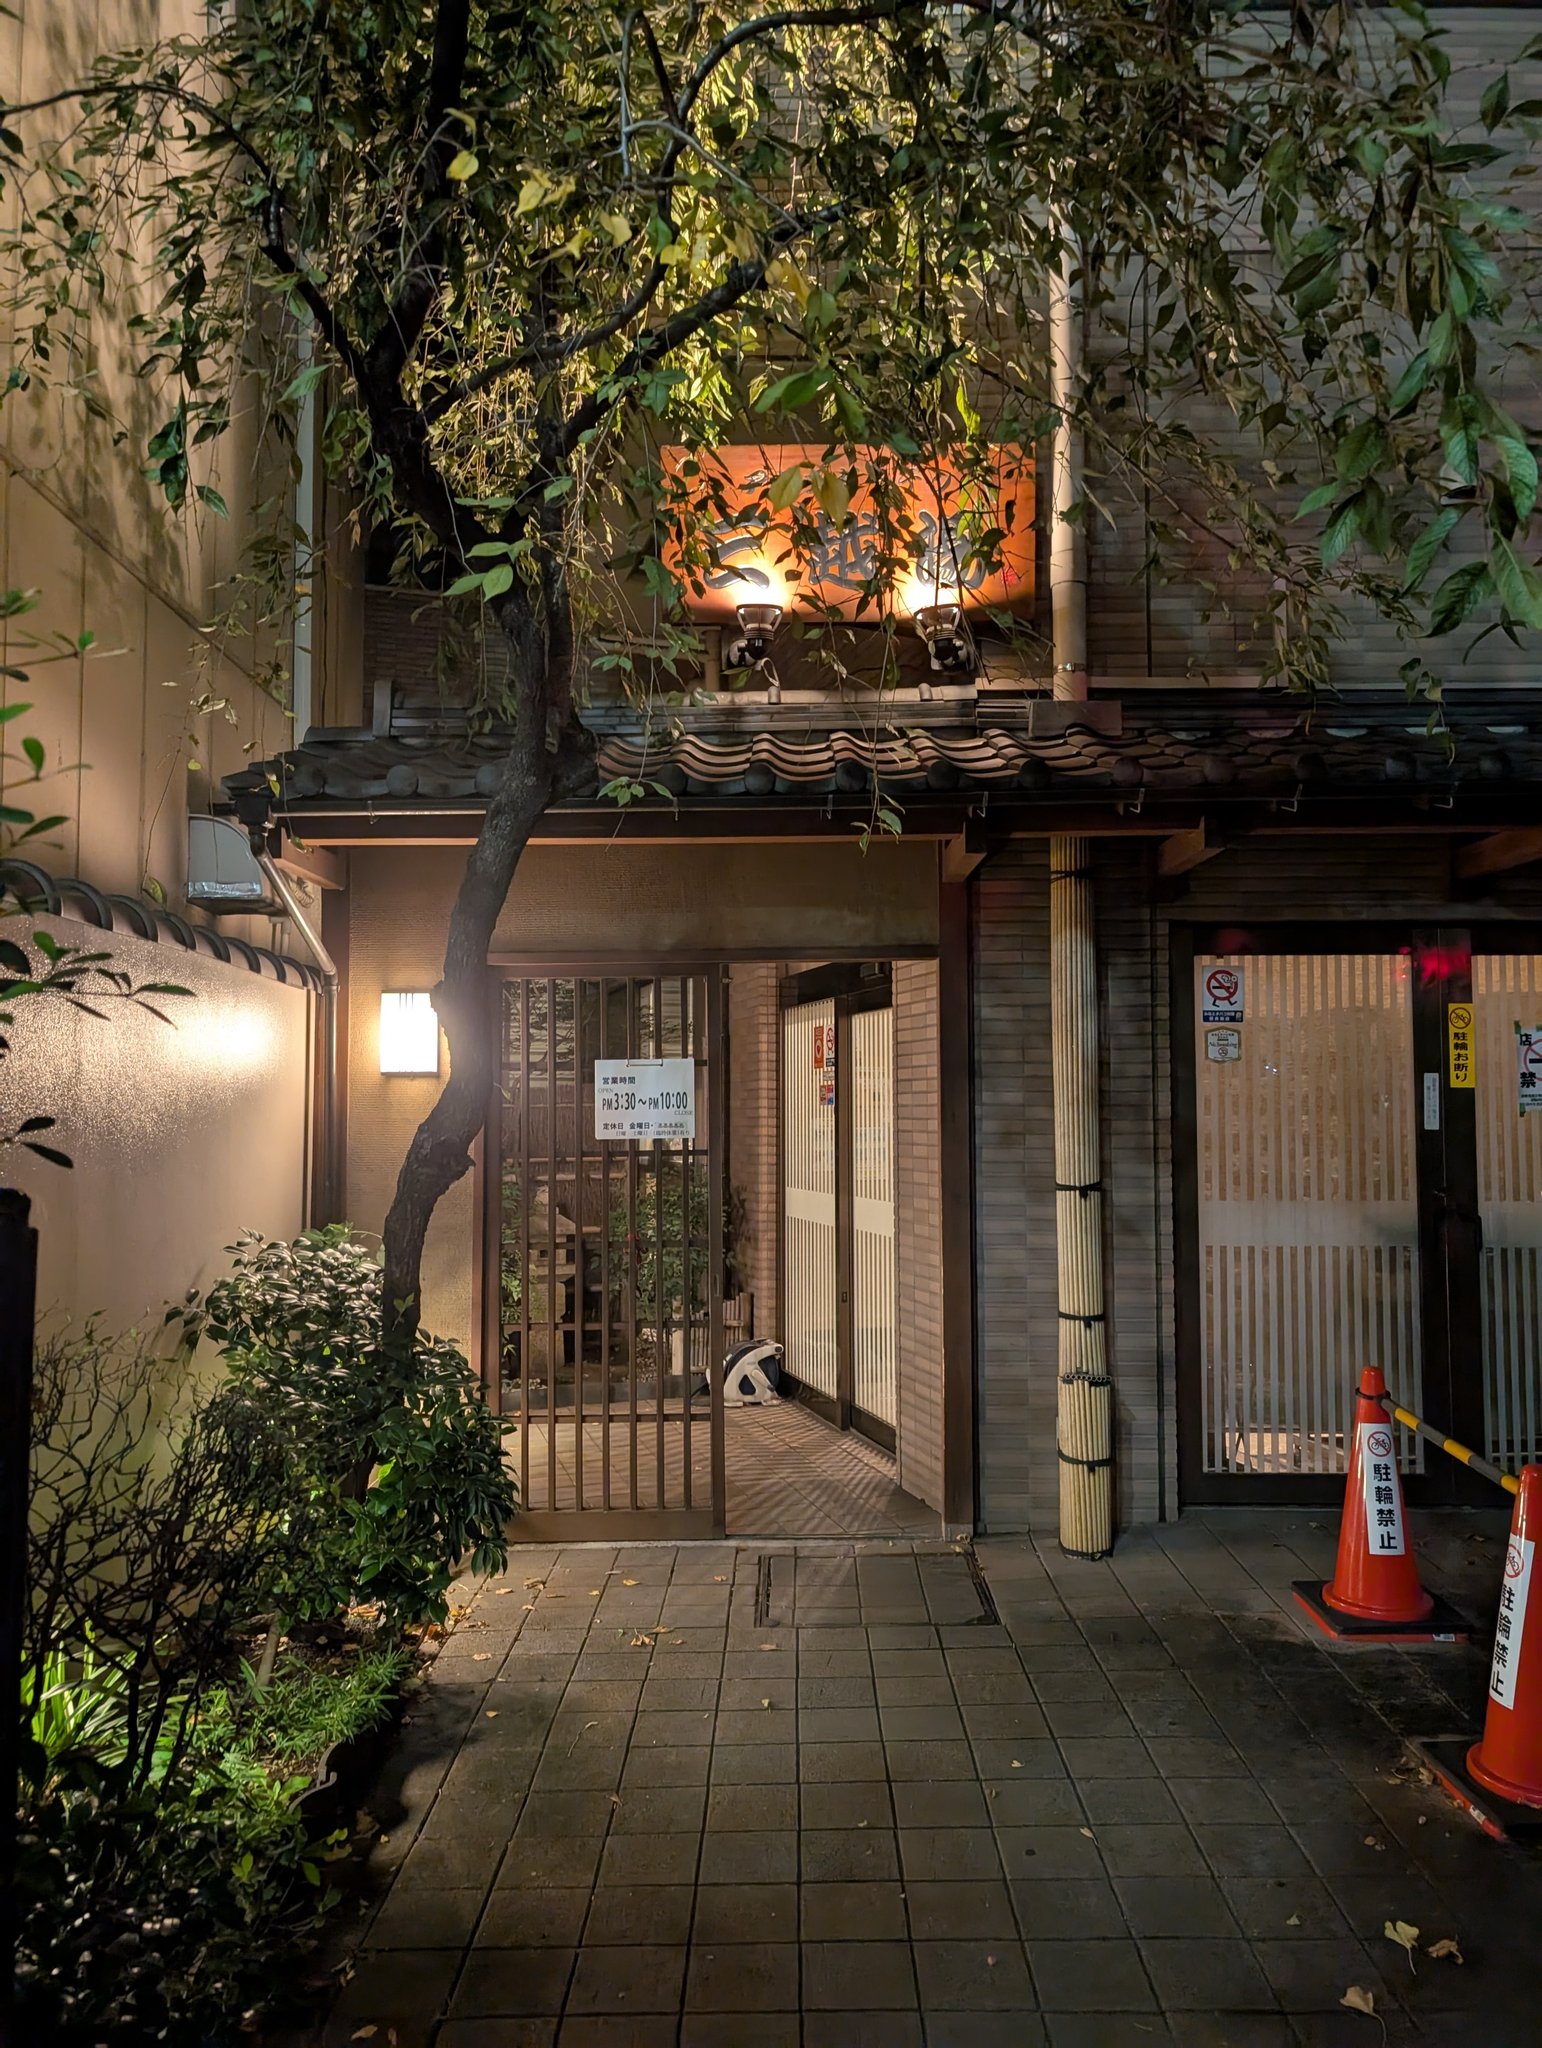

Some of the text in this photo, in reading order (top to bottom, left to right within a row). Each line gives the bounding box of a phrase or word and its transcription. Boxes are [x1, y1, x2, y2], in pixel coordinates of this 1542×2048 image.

[1519, 1033, 1532, 1046] 店
[1453, 1032, 1469, 1082] 駐輪お断り
[602, 1076, 636, 1085] 営業時間
[1520, 1072, 1536, 1088] 禁
[602, 1122, 624, 1130] 定休日
[1373, 1463, 1398, 1550] 駐輪禁止
